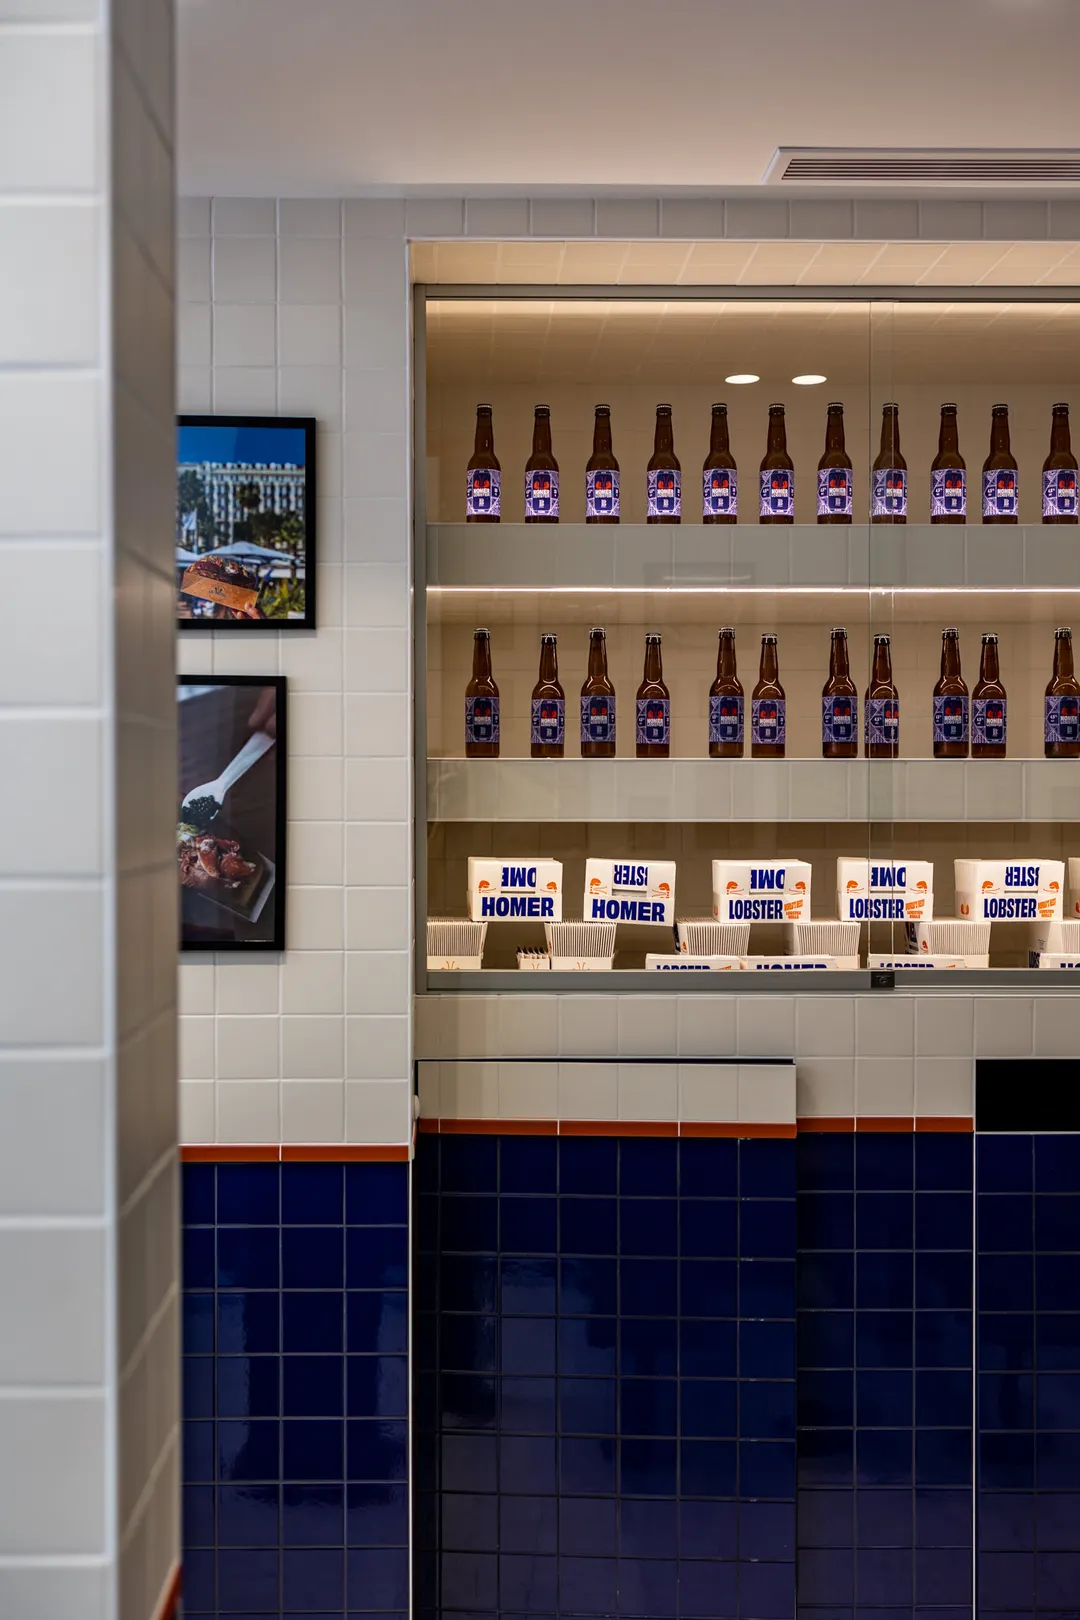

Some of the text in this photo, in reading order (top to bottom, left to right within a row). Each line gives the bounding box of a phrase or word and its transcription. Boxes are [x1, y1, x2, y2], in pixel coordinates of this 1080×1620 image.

[482, 897, 554, 917] HOMER
[592, 899, 665, 922] HOMER
[729, 900, 783, 920] LOBSTER
[849, 898, 904, 918] LOBSTER
[984, 898, 1037, 918] LOBSTER
